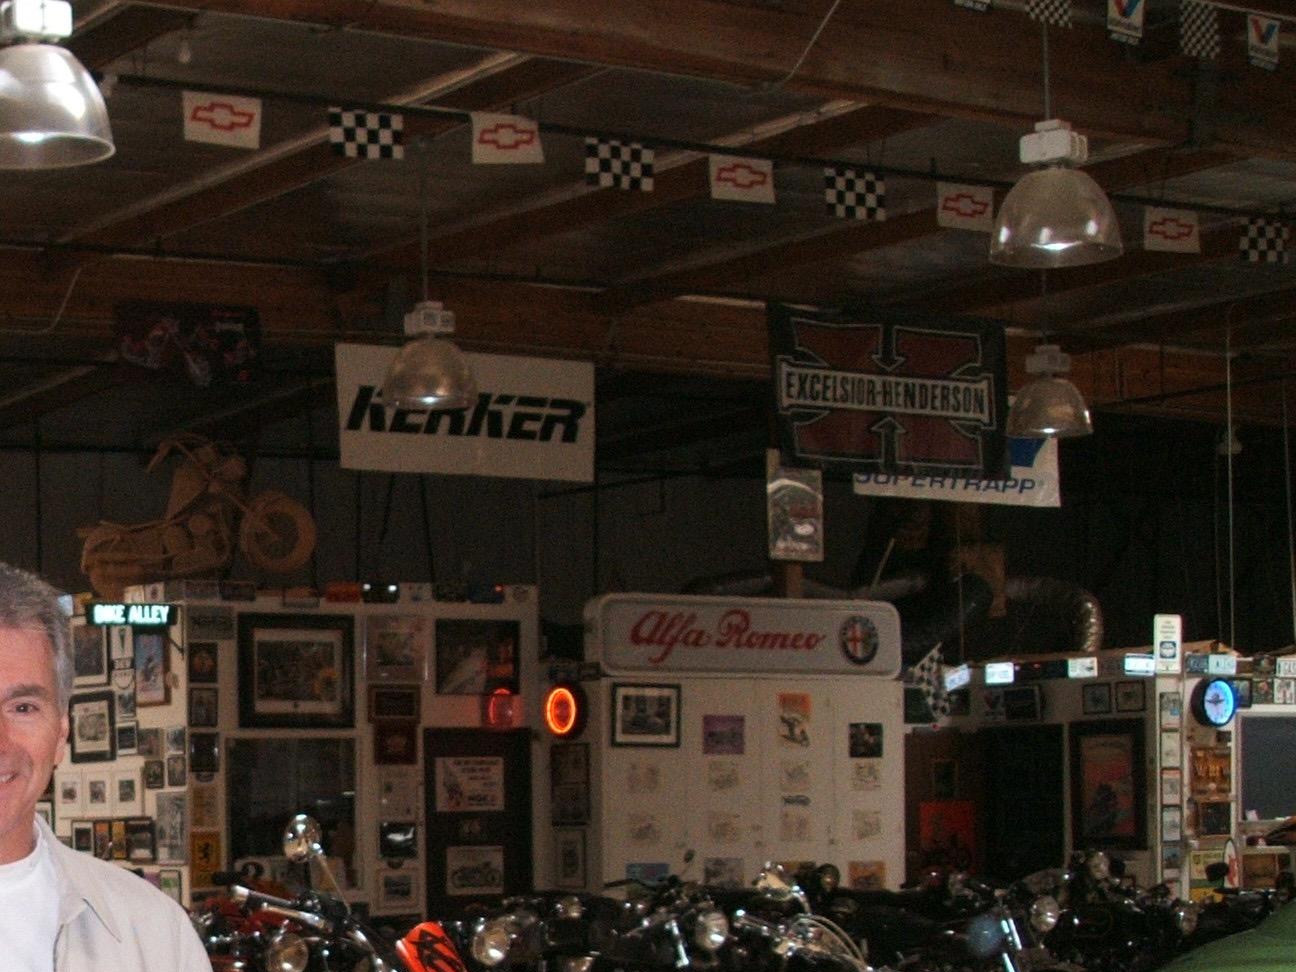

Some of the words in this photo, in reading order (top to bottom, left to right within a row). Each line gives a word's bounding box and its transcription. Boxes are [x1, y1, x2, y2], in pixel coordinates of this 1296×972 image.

[785, 371, 986, 415] EXCELSIOR-HENDERSON
[128, 604, 170, 624] ALLEY
[631, 610, 711, 665] Alfa
[716, 609, 825, 650] Romeo
